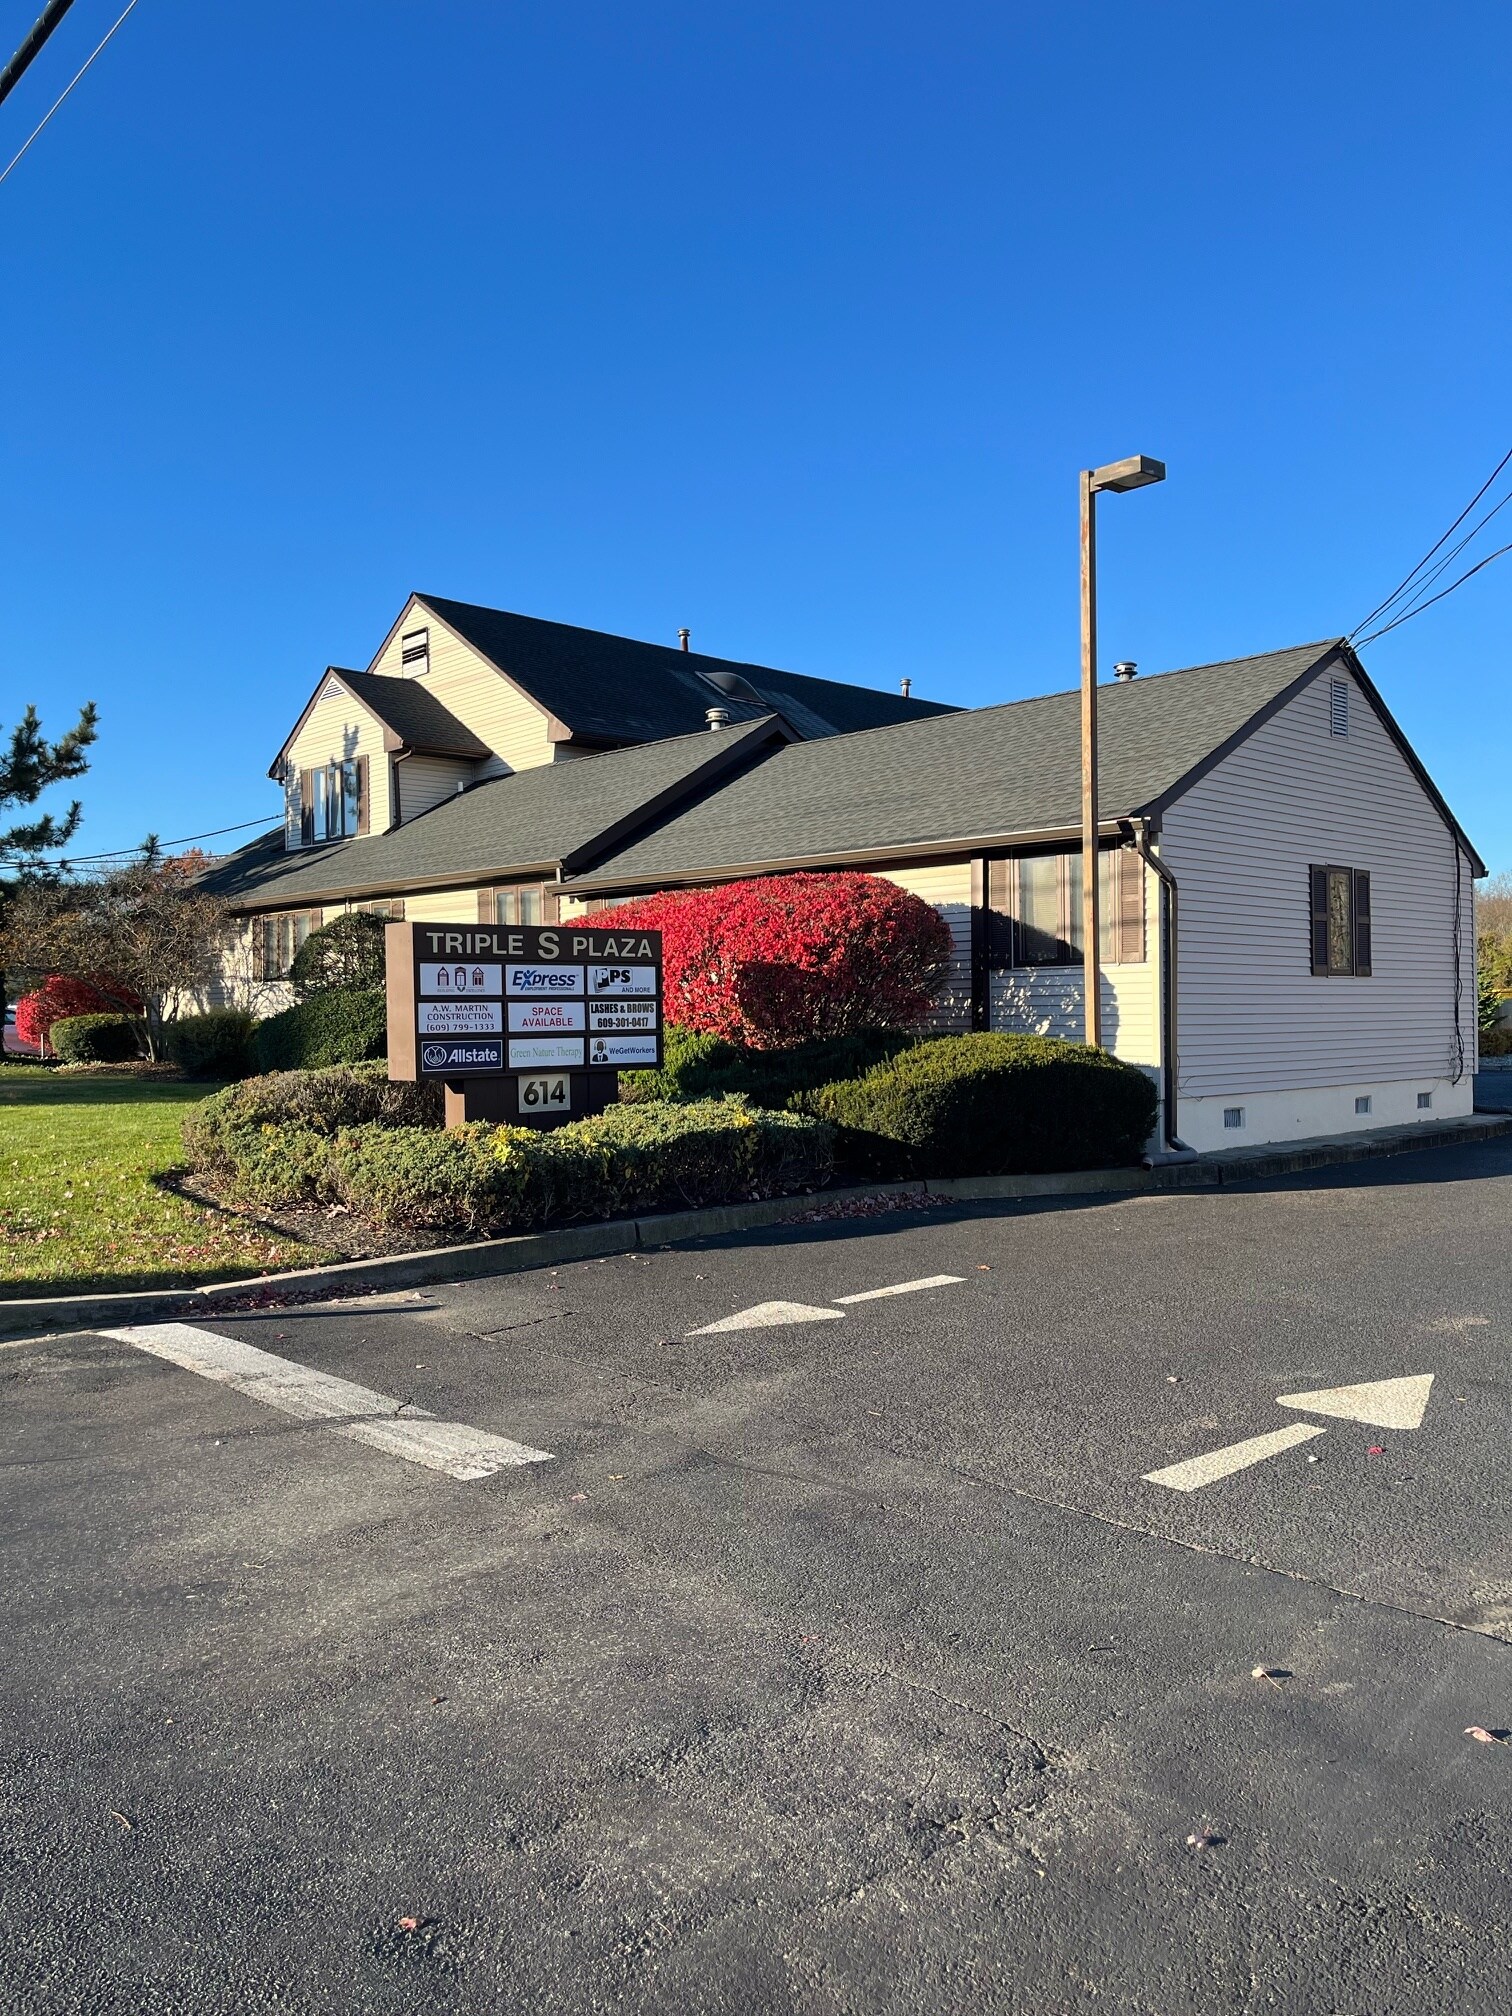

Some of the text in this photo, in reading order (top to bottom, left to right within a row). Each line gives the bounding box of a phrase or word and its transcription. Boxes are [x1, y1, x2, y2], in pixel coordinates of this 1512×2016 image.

[426, 931, 653, 960] TRIPLE S PLAZA
[512, 969, 576, 991] Express
[432, 1004, 489, 1012] A.W. MARTIN
[532, 1007, 563, 1016] SPACE
[590, 1003, 655, 1014] LASHES & BROWS
[427, 1012, 494, 1021] CONSTRUCTION
[522, 1017, 573, 1027] AVAILABLE
[426, 1023, 495, 1032] (609) 799-1333
[597, 1017, 649, 1028] 609-301-0417
[447, 1047, 498, 1063] Allstate
[510, 1046, 583, 1059] Green Nature Therapy
[609, 1046, 655, 1055] WeGetWorkers
[523, 1080, 566, 1107] 614
